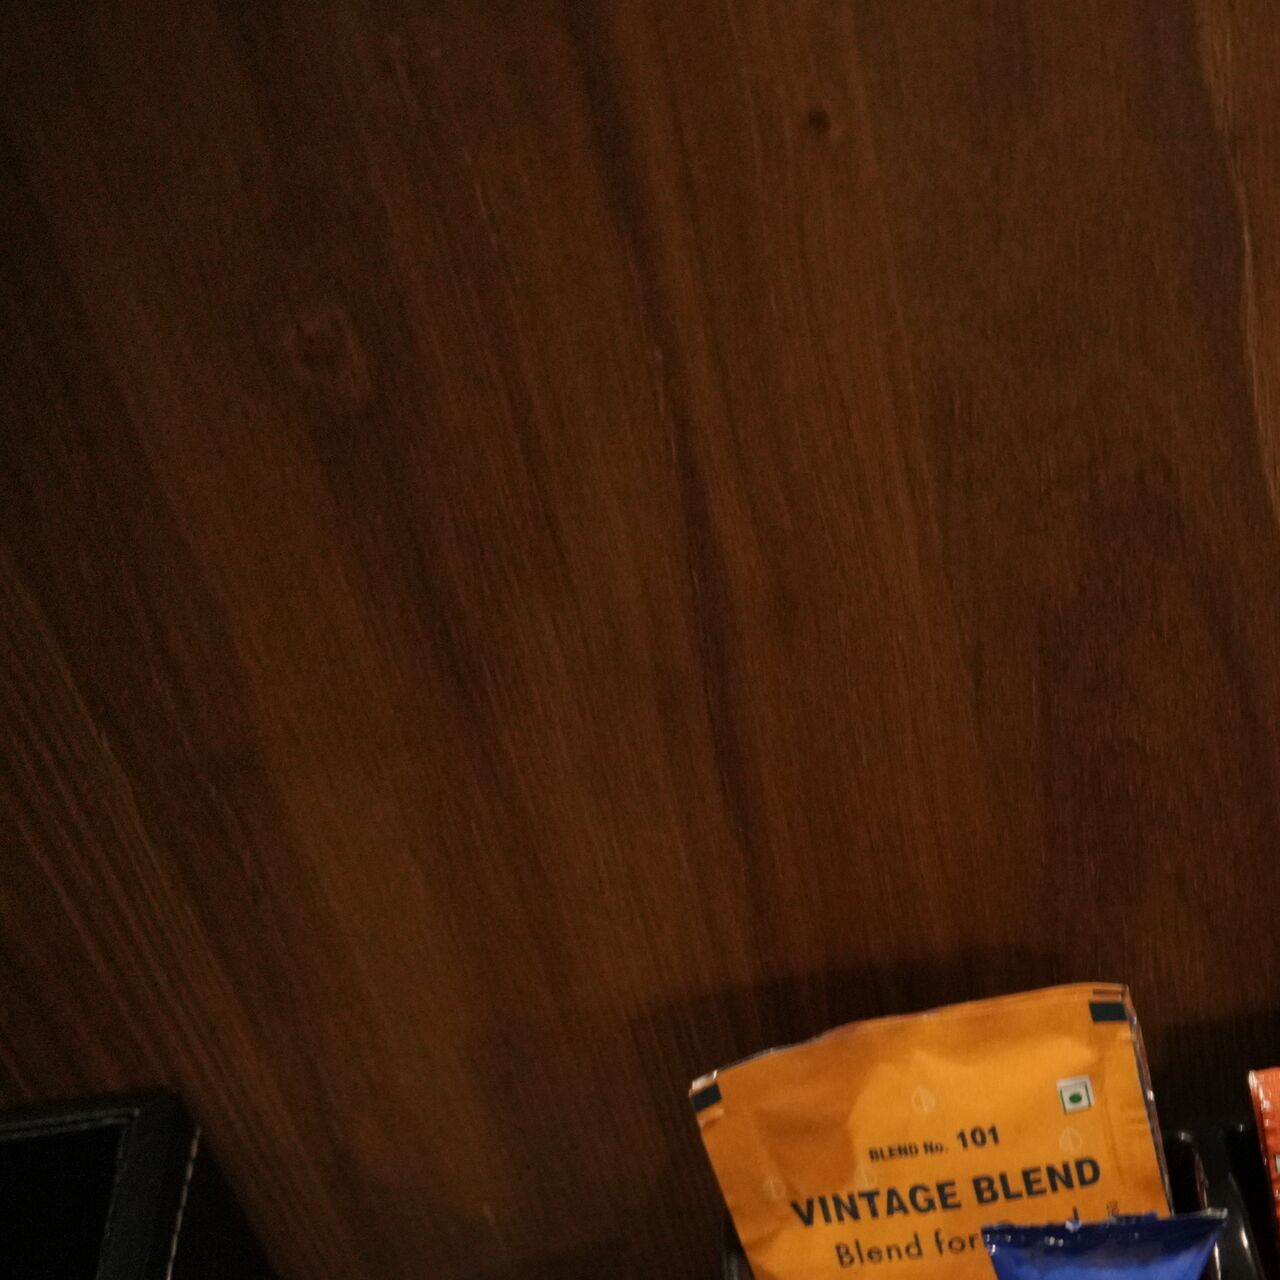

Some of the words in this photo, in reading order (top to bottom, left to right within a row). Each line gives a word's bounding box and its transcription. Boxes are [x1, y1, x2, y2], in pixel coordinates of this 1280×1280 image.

[869, 1142, 919, 1162] BLEND
[956, 1125, 1000, 1149] 101
[790, 1179, 962, 1227] VINTAGE
[972, 1156, 1101, 1205] BLEND
[834, 1231, 923, 1269] Blend
[934, 1227, 979, 1256] for
